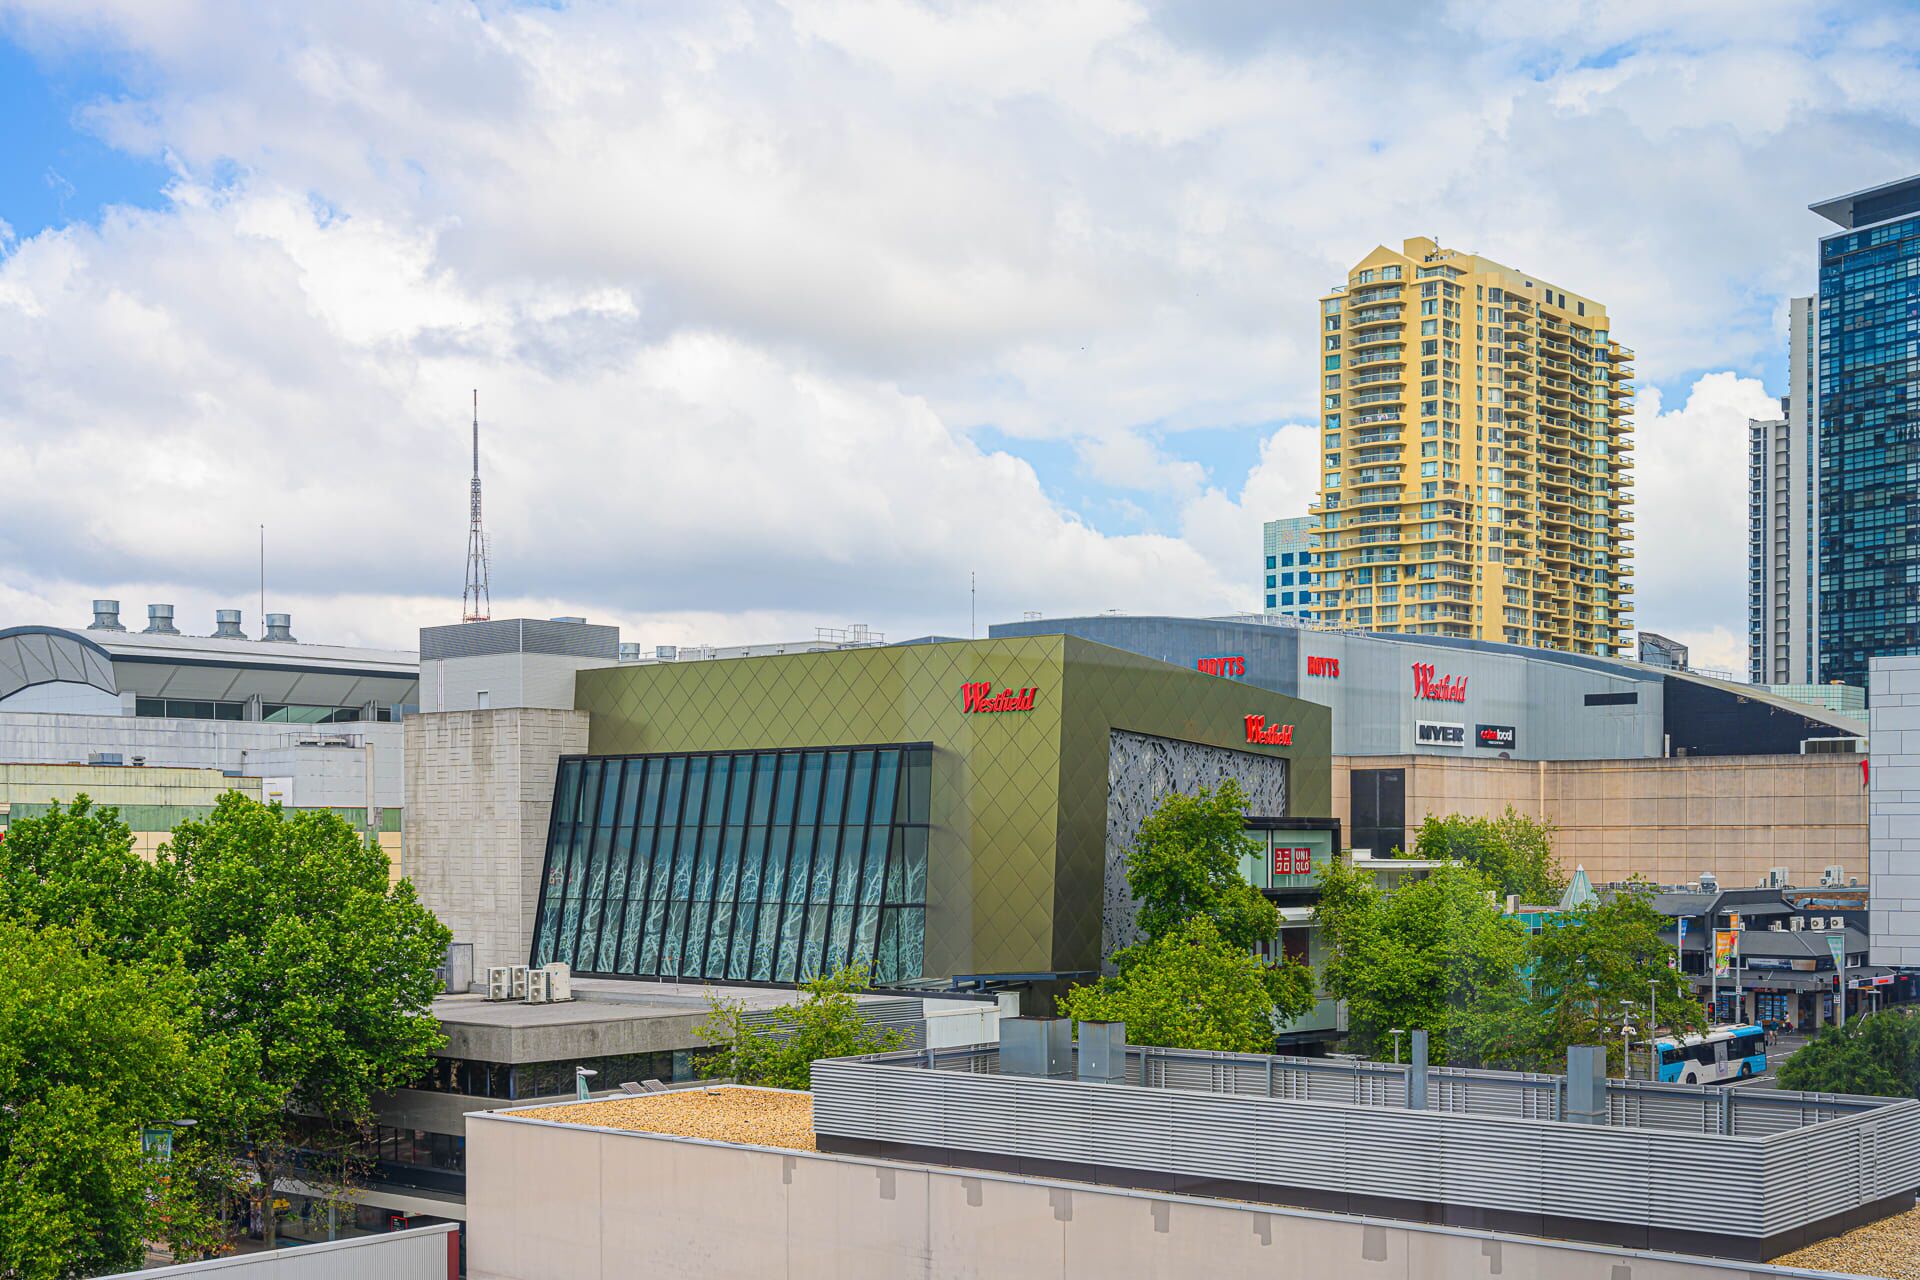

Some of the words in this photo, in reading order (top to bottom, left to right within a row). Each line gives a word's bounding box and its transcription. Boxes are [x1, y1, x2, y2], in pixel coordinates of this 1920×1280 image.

[1198, 656, 1245, 676] HOYTS
[1307, 656, 1340, 677] HOYTS
[1412, 661, 1468, 703] Westfield
[960, 681, 1038, 714] Westfield
[1244, 714, 1294, 746] Westfield
[1419, 725, 1464, 741] MYER
[1296, 851, 1308, 860] UNI
[1296, 862, 1309, 873] QLO
